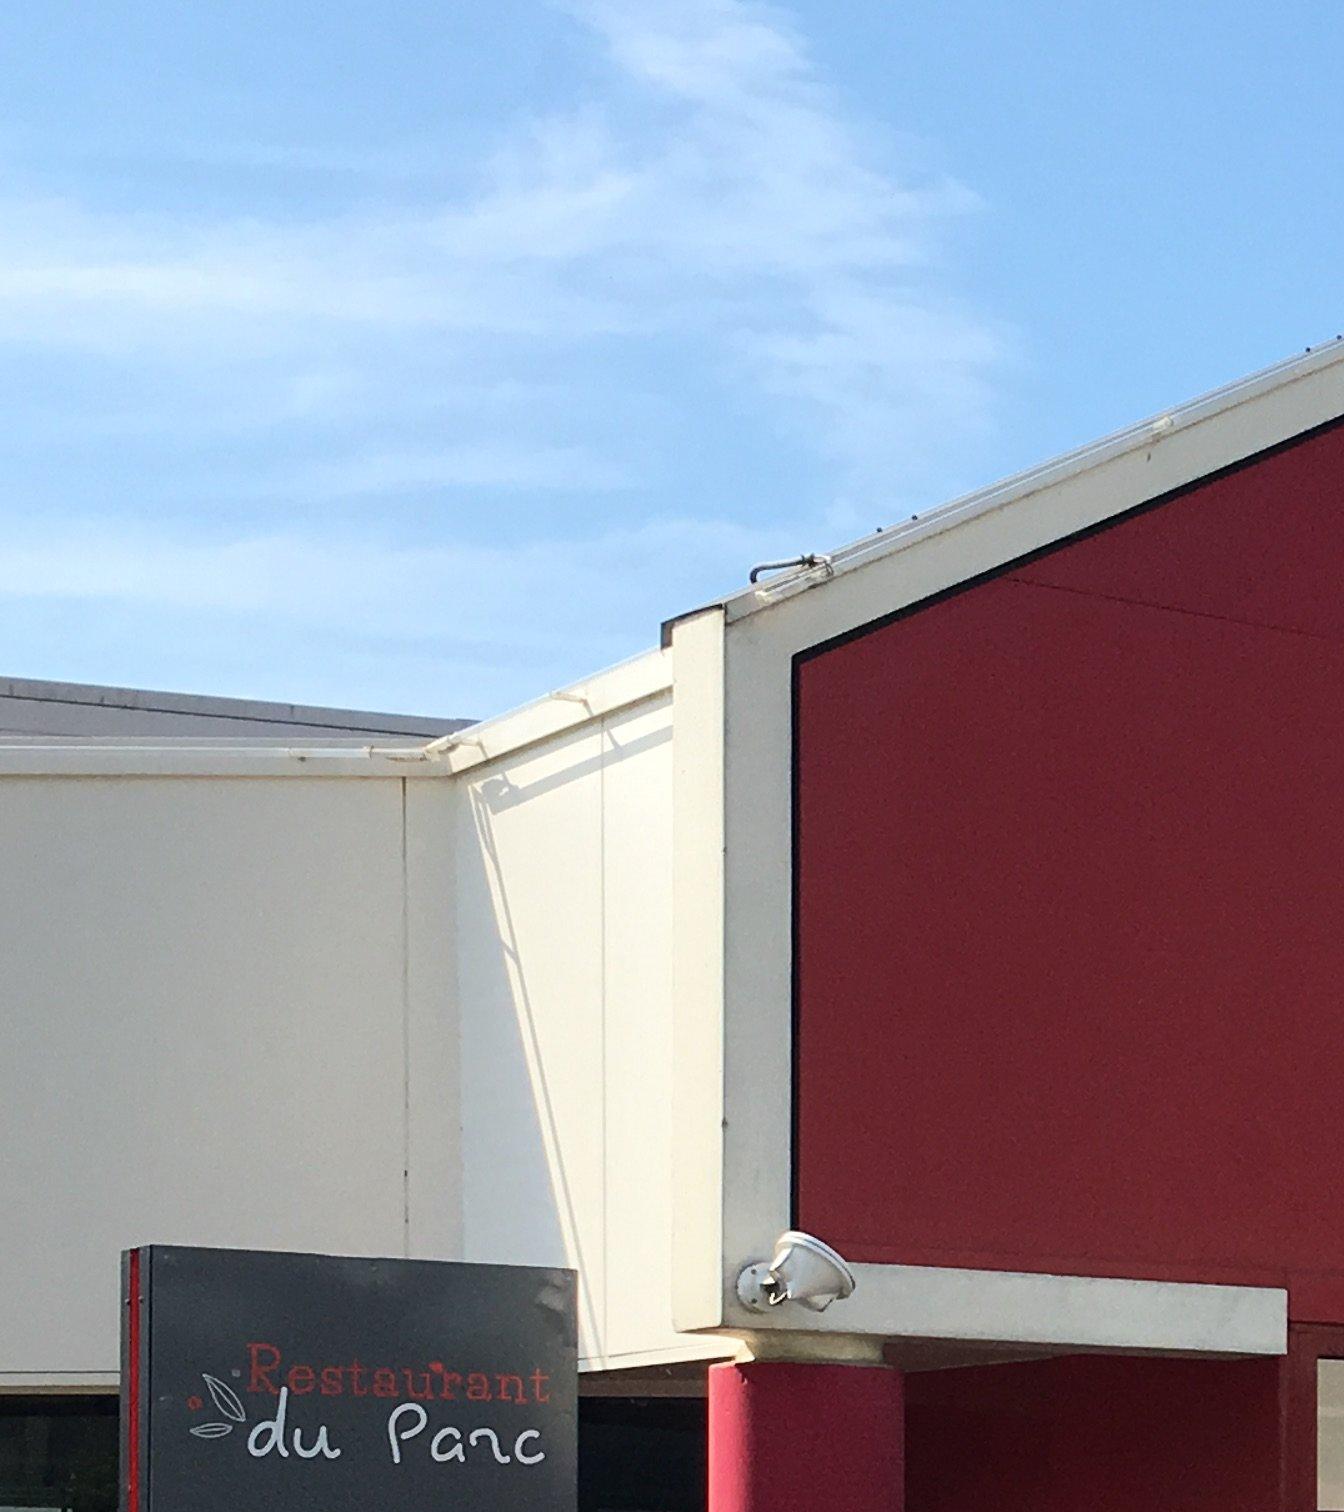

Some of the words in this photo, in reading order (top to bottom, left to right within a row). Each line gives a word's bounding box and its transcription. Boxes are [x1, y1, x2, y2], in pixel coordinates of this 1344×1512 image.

[245, 1342, 550, 1403] Restaurant
[247, 1386, 341, 1459] du
[388, 1402, 546, 1465] Parc
